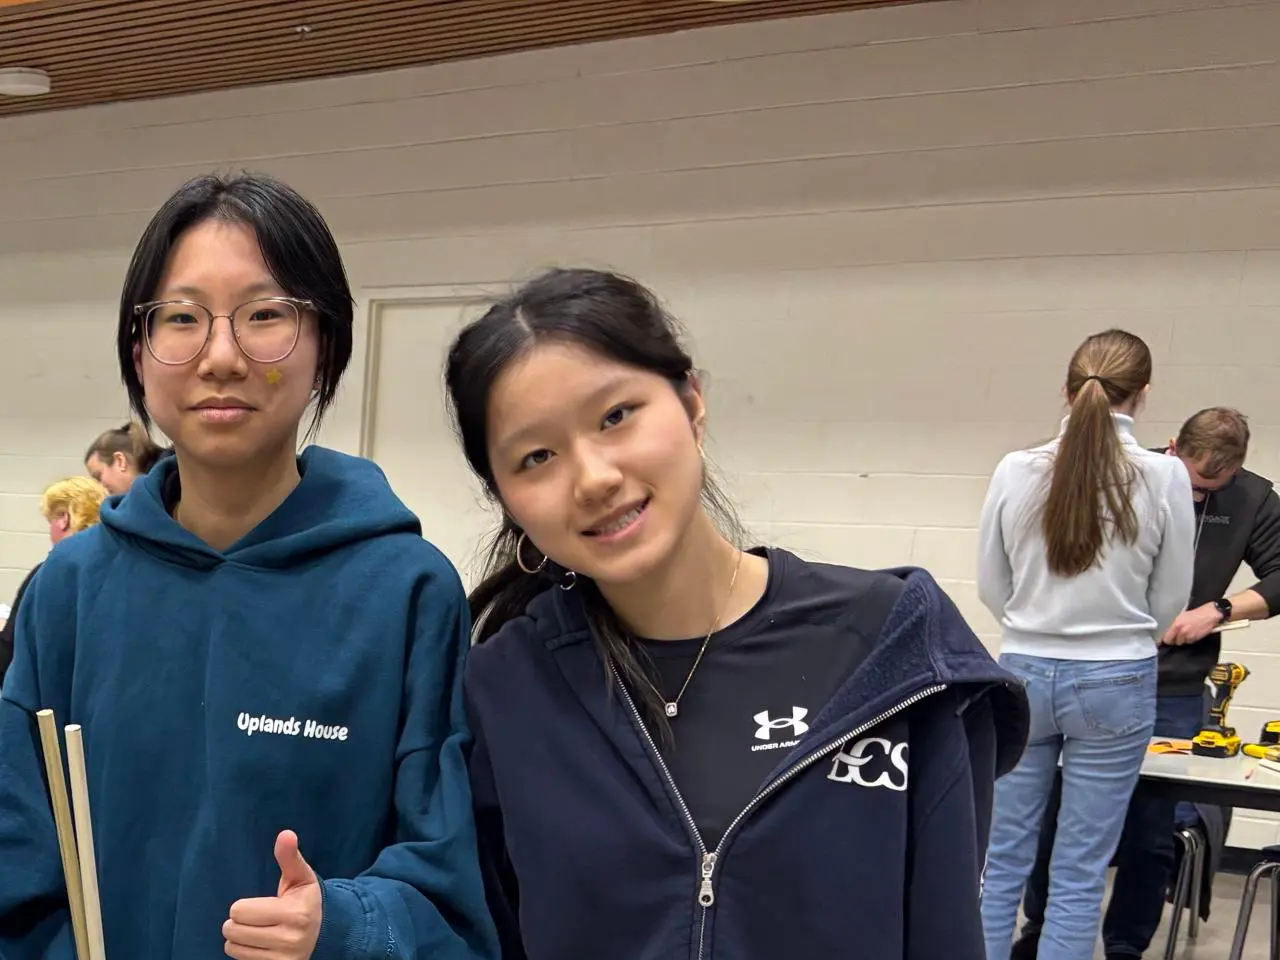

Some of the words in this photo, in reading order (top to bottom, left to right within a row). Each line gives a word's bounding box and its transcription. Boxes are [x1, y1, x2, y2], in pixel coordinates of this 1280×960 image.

[237, 712, 301, 736] Uplands
[304, 719, 348, 741] House
[751, 742, 778, 752] UNDER
[779, 739, 801, 748] ARM
